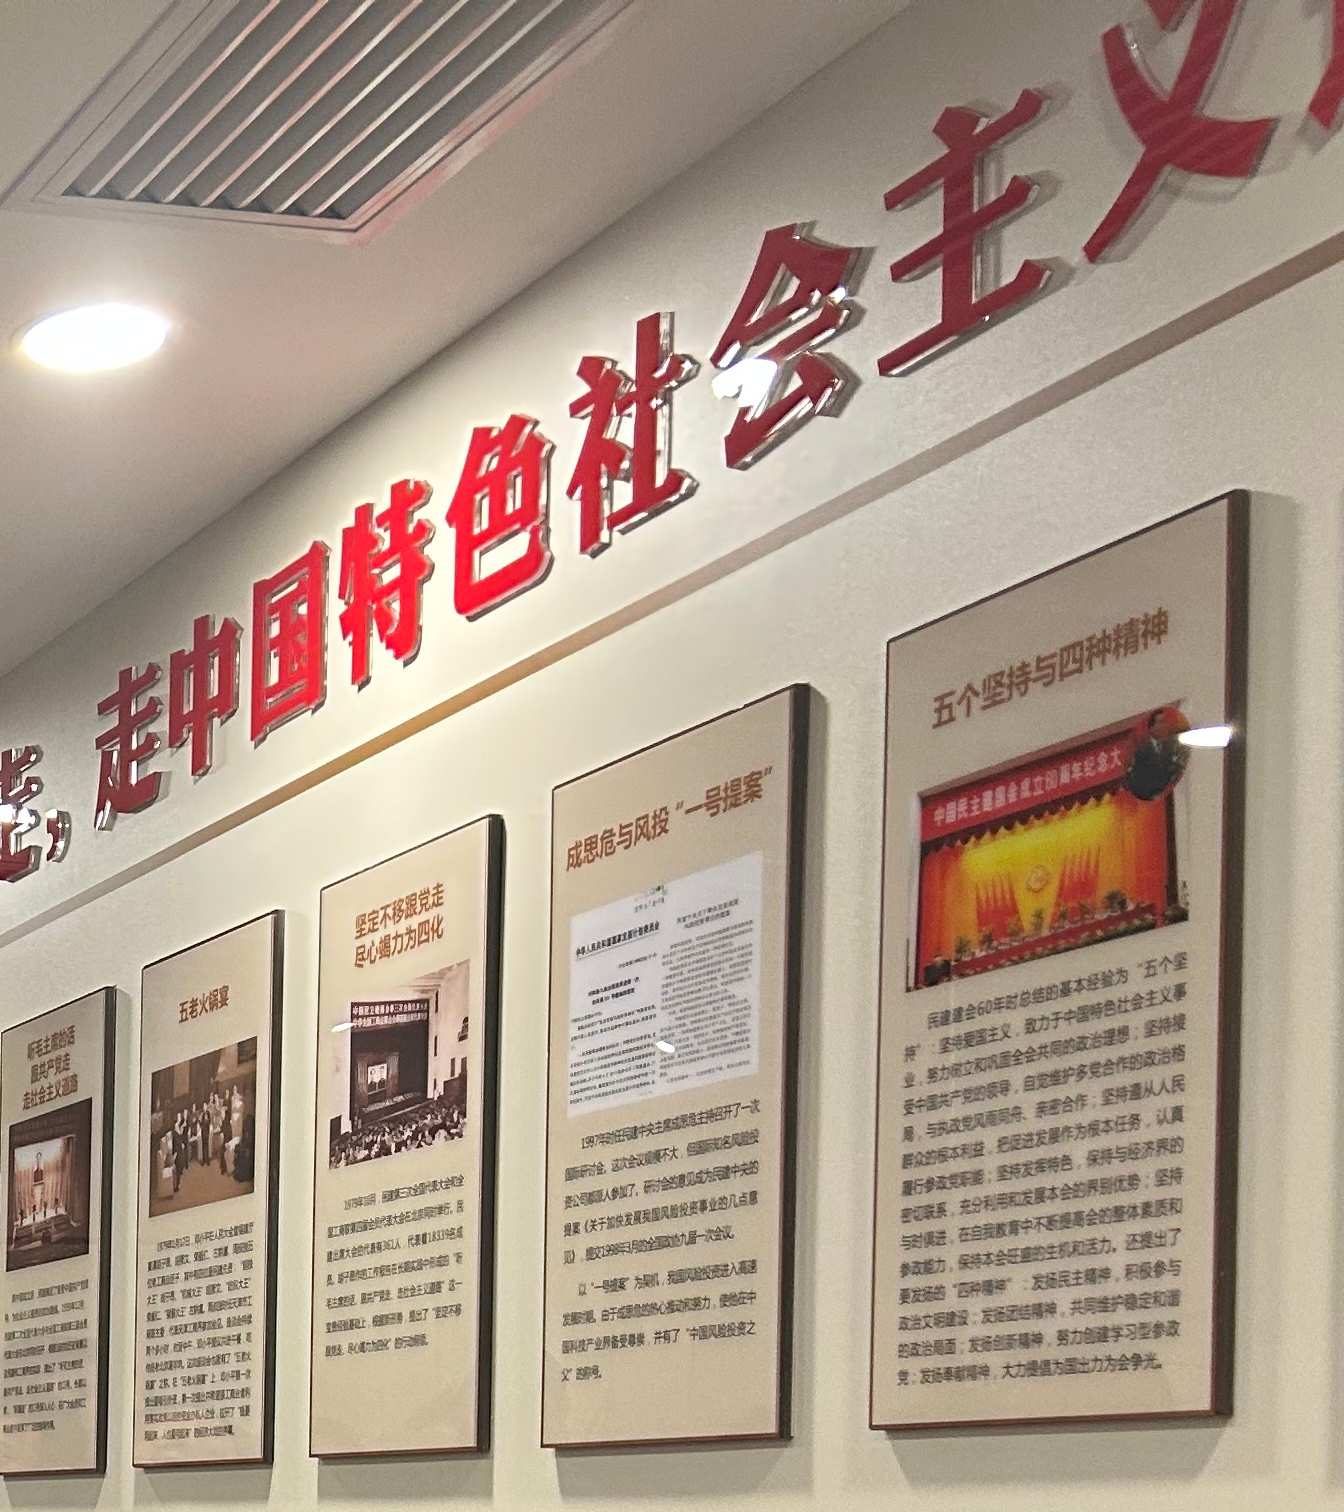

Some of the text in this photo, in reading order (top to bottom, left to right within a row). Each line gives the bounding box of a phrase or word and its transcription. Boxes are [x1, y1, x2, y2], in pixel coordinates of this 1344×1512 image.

[932, 606, 1170, 729] 五个坚持与四种精神
[566, 766, 773, 872] 成思危与风投“一号提案”
[355, 882, 444, 940] 坚定不移跟党走
[354, 913, 444, 968] 尽心竭力为四化
[178, 985, 230, 1024] 五老火锅宴
[22, 1074, 78, 1111] 走社会主义道路
